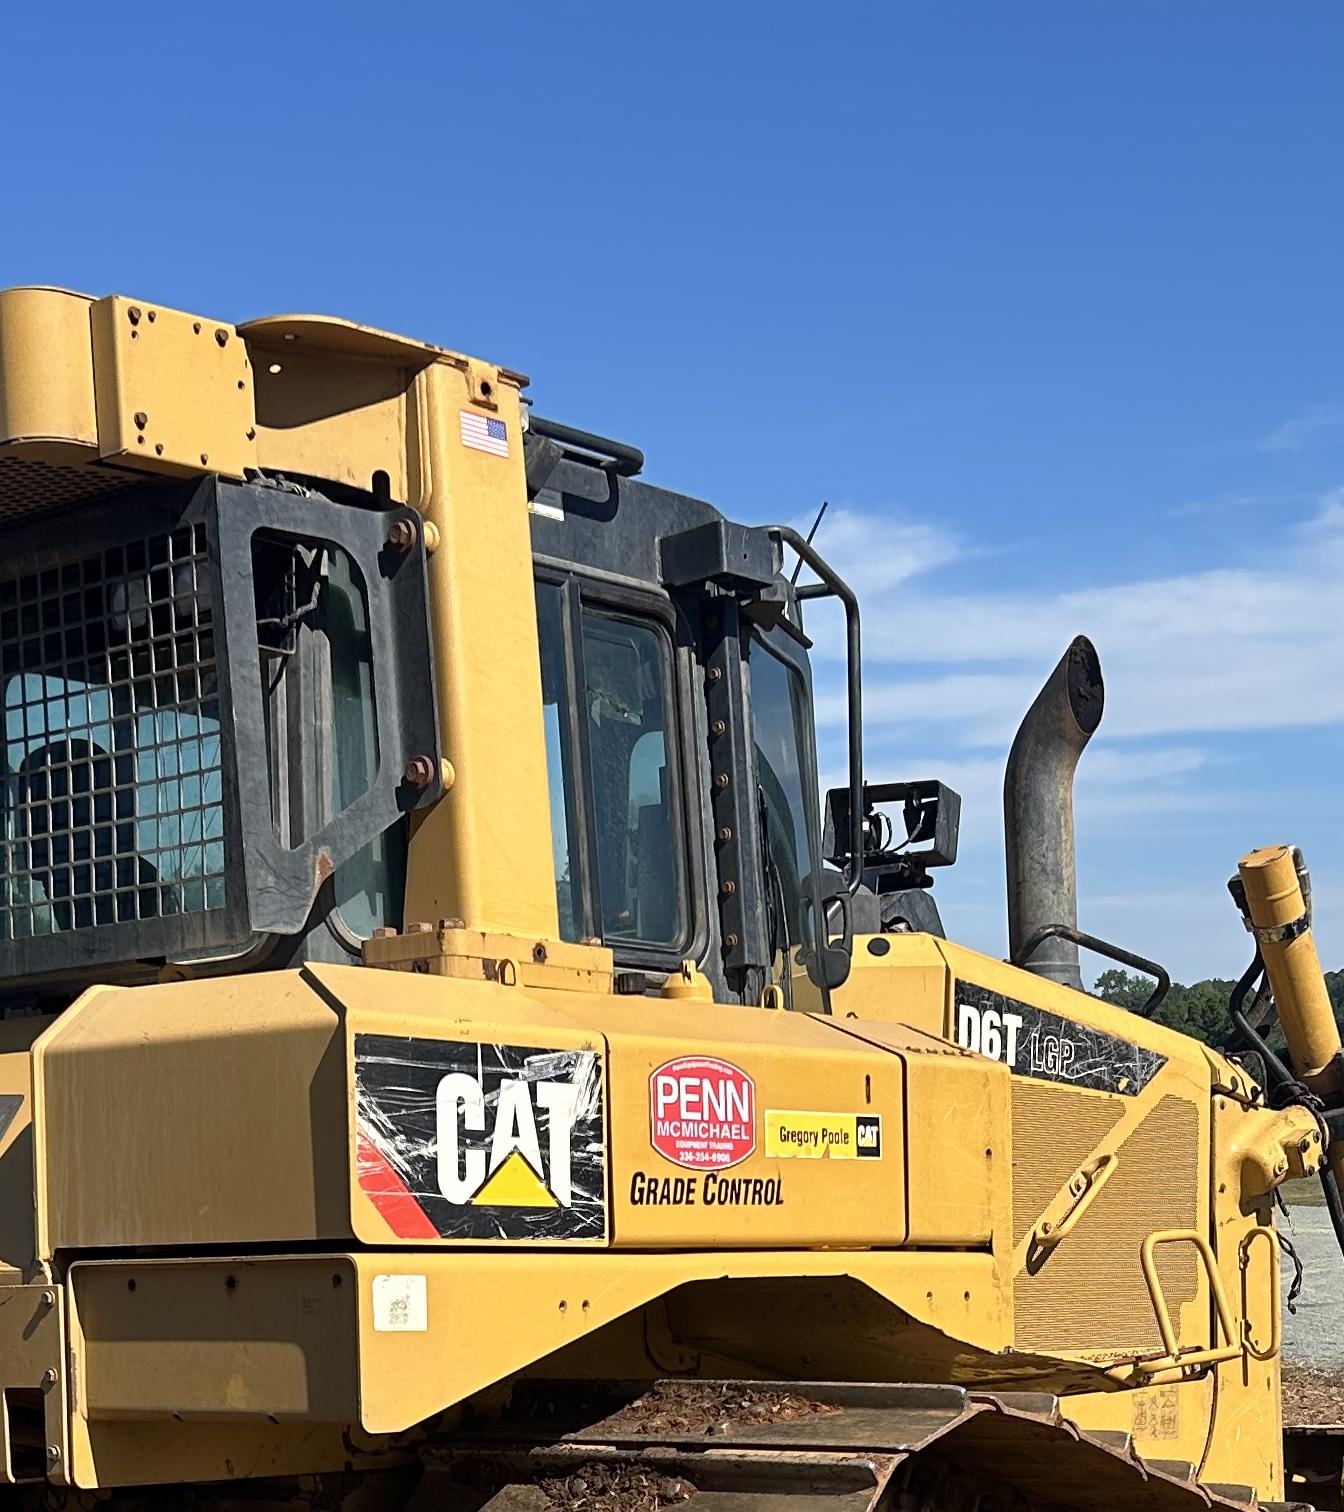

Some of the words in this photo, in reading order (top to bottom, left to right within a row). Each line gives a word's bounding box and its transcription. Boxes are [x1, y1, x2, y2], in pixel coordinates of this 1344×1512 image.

[958, 1004, 1023, 1068] D6T
[1031, 1032, 1076, 1076] LGP
[656, 1075, 750, 1123] PENN
[435, 1071, 581, 1208] CAT
[656, 1120, 751, 1141] MCMICHAEL
[779, 1125, 819, 1148] Gregory
[822, 1127, 850, 1145] Poole
[857, 1124, 879, 1148] CAT
[630, 1171, 697, 1206] GRADE
[702, 1172, 784, 1206] CONTROL
